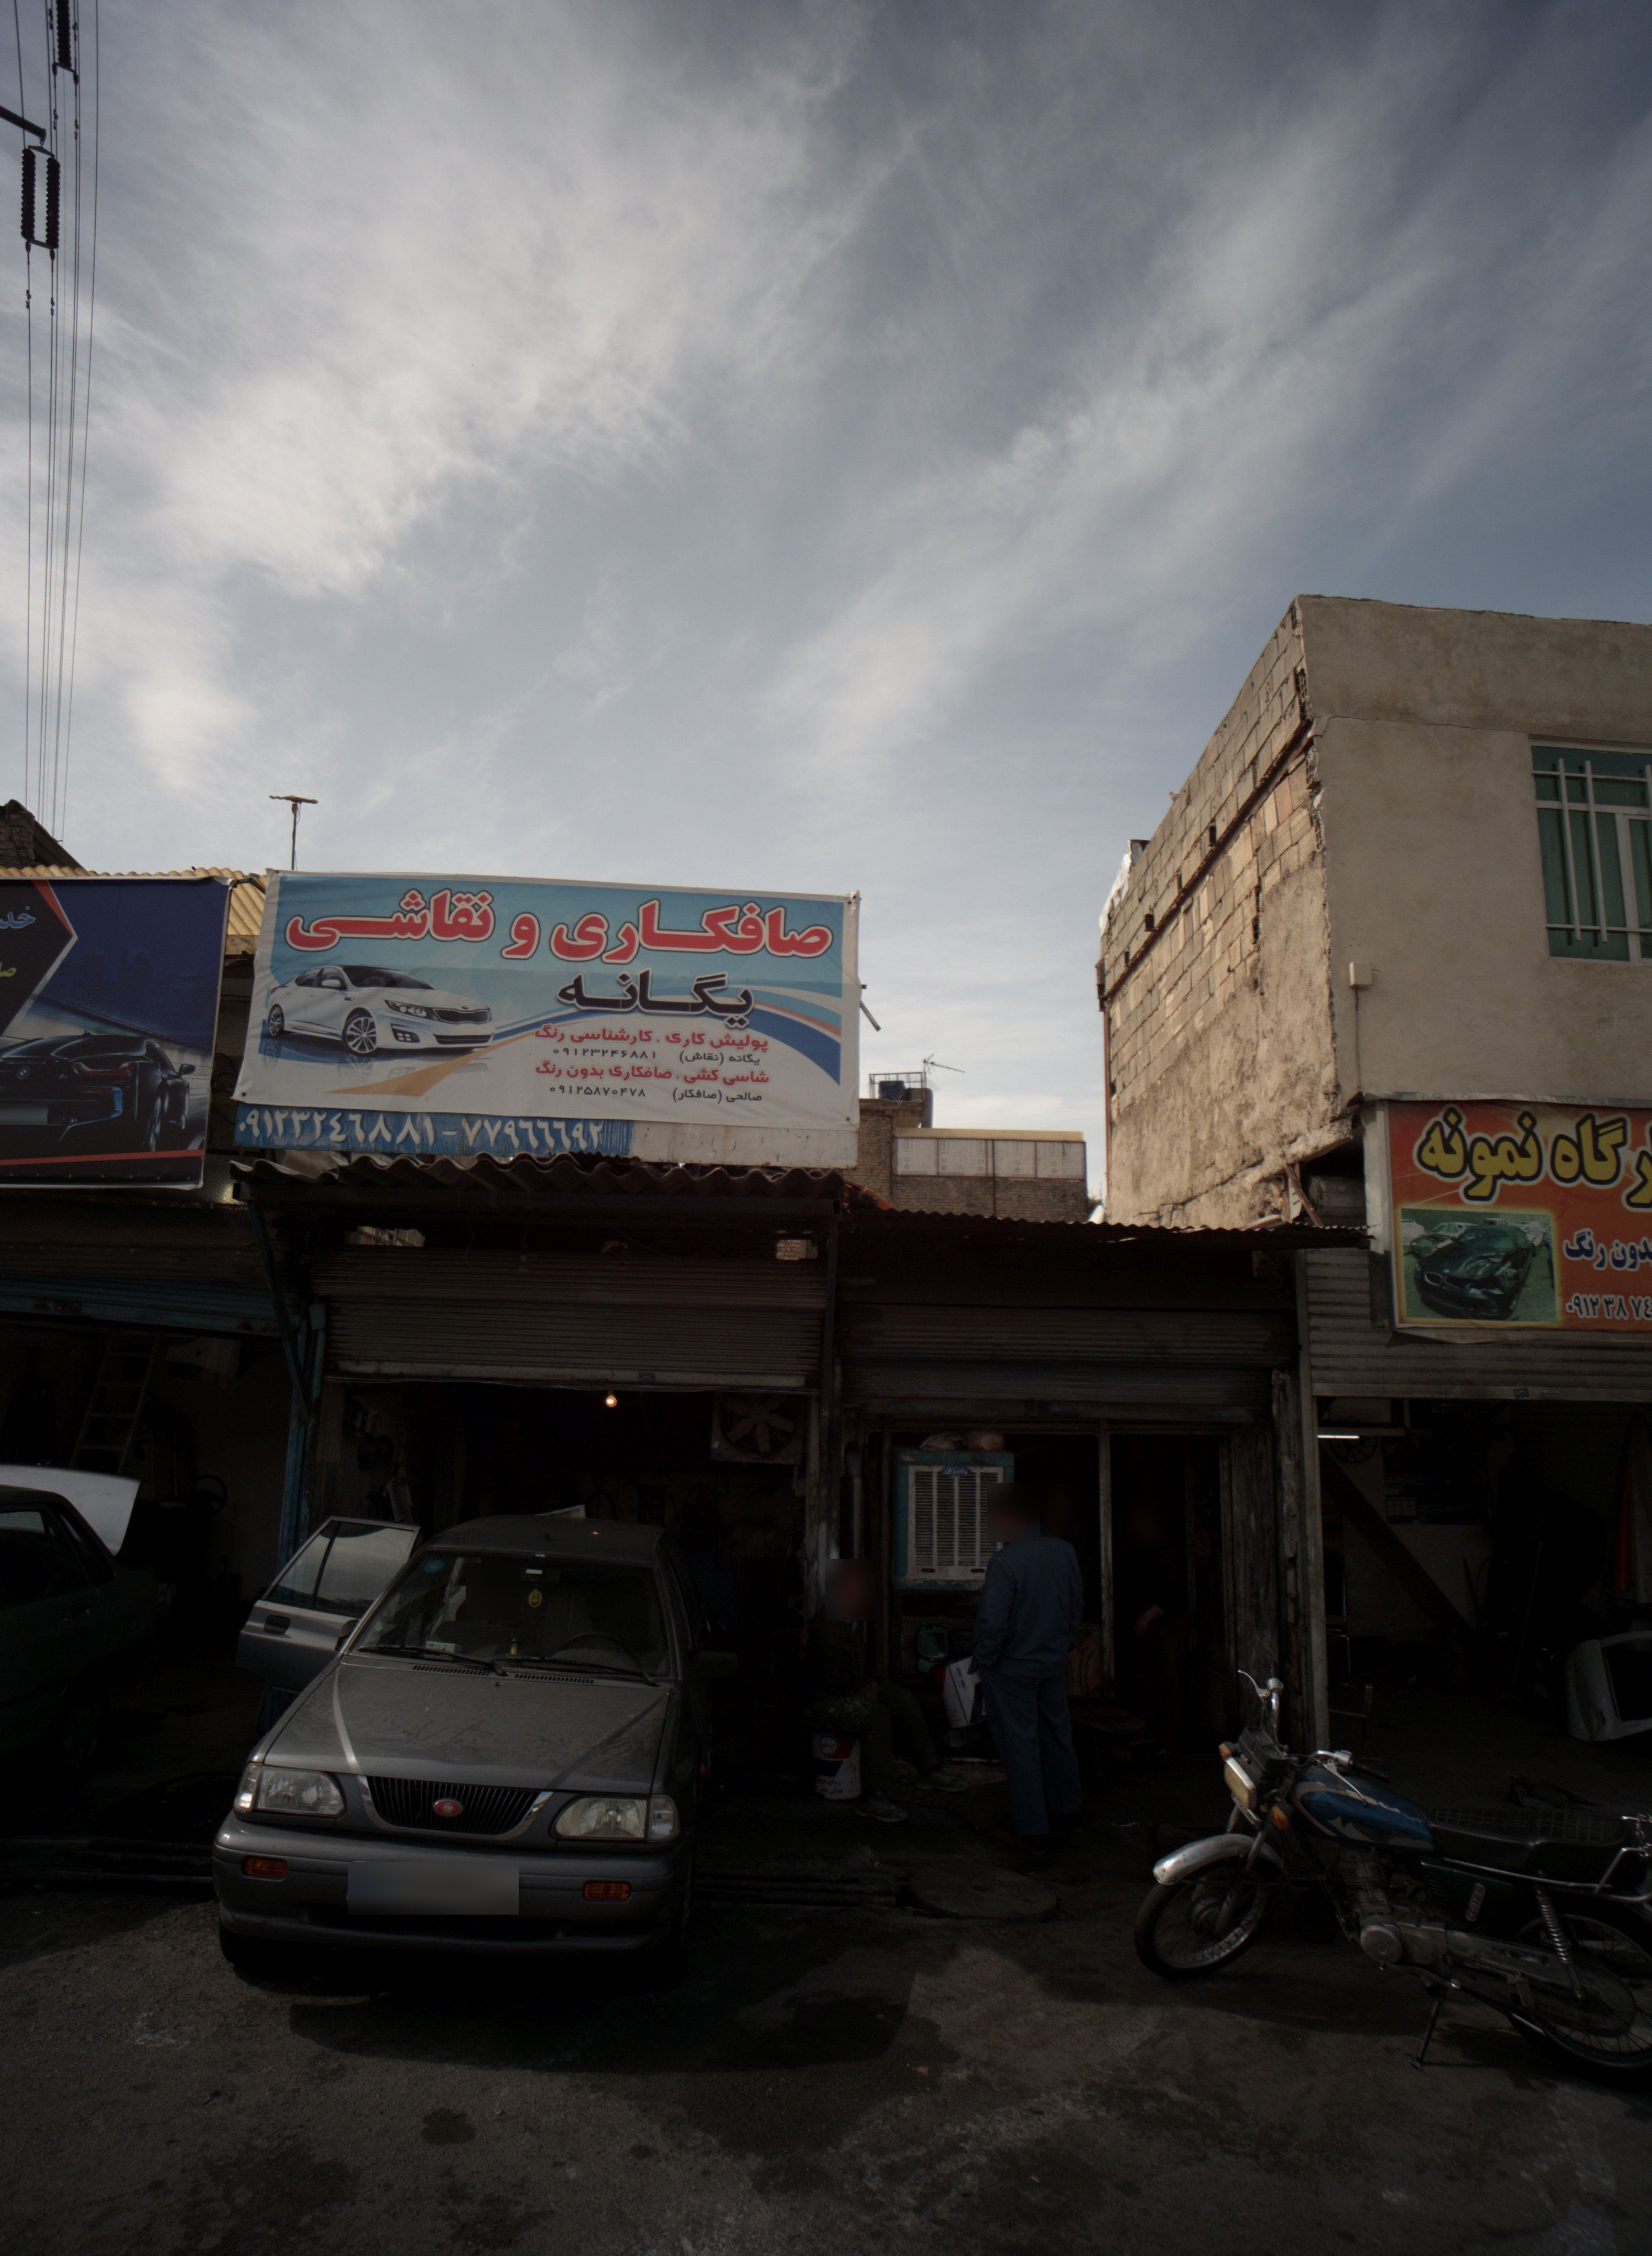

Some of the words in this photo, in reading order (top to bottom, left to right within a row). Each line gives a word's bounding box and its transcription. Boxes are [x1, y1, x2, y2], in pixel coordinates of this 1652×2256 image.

[284, 888, 495, 951] نقاشی
[501, 910, 540, 960] و
[551, 899, 834, 963] صافکاری
[556, 968, 756, 1029] یگانه
[534, 1025, 566, 1043] رنگ
[570, 1028, 653, 1045] کارشناسی
[665, 1031, 706, 1046] کاری
[709, 1033, 769, 1053] پولیش
[729, 1054, 761, 1065] یگانه
[535, 1060, 563, 1078] رنگ
[566, 1063, 605, 1080] بدون
[608, 1064, 673, 1082] صافکاری
[683, 1067, 719, 1084] کشی
[722, 1069, 770, 1086] شاسی
[726, 1091, 763, 1104] صالحی
[1417, 1107, 1544, 1201] نمونه
[1550, 1113, 1652, 1208] رگاه
[1565, 1230, 1606, 1268] رنگ
[1612, 1239, 1652, 1269] دون
